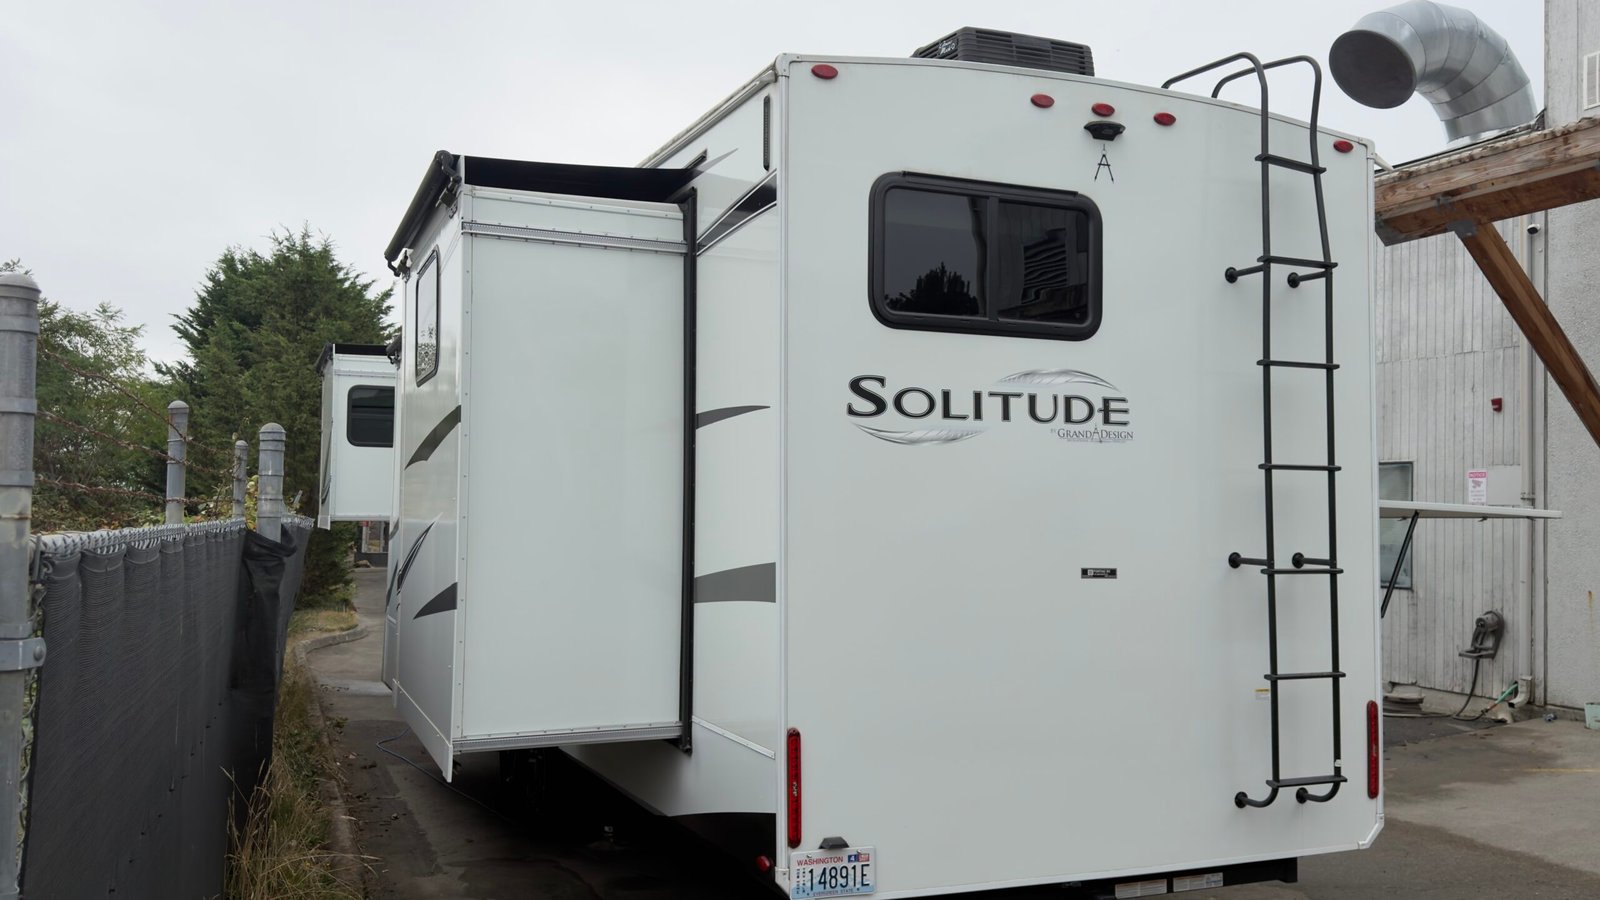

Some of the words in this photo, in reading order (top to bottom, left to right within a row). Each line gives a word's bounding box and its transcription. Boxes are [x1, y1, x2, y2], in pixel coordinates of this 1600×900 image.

[847, 374, 1130, 427] SOLITUDE
[1057, 428, 1092, 439] GRAND
[1100, 429, 1135, 440] DESIGN
[797, 856, 843, 866] WASHINGTON
[808, 864, 870, 891] 14891E
